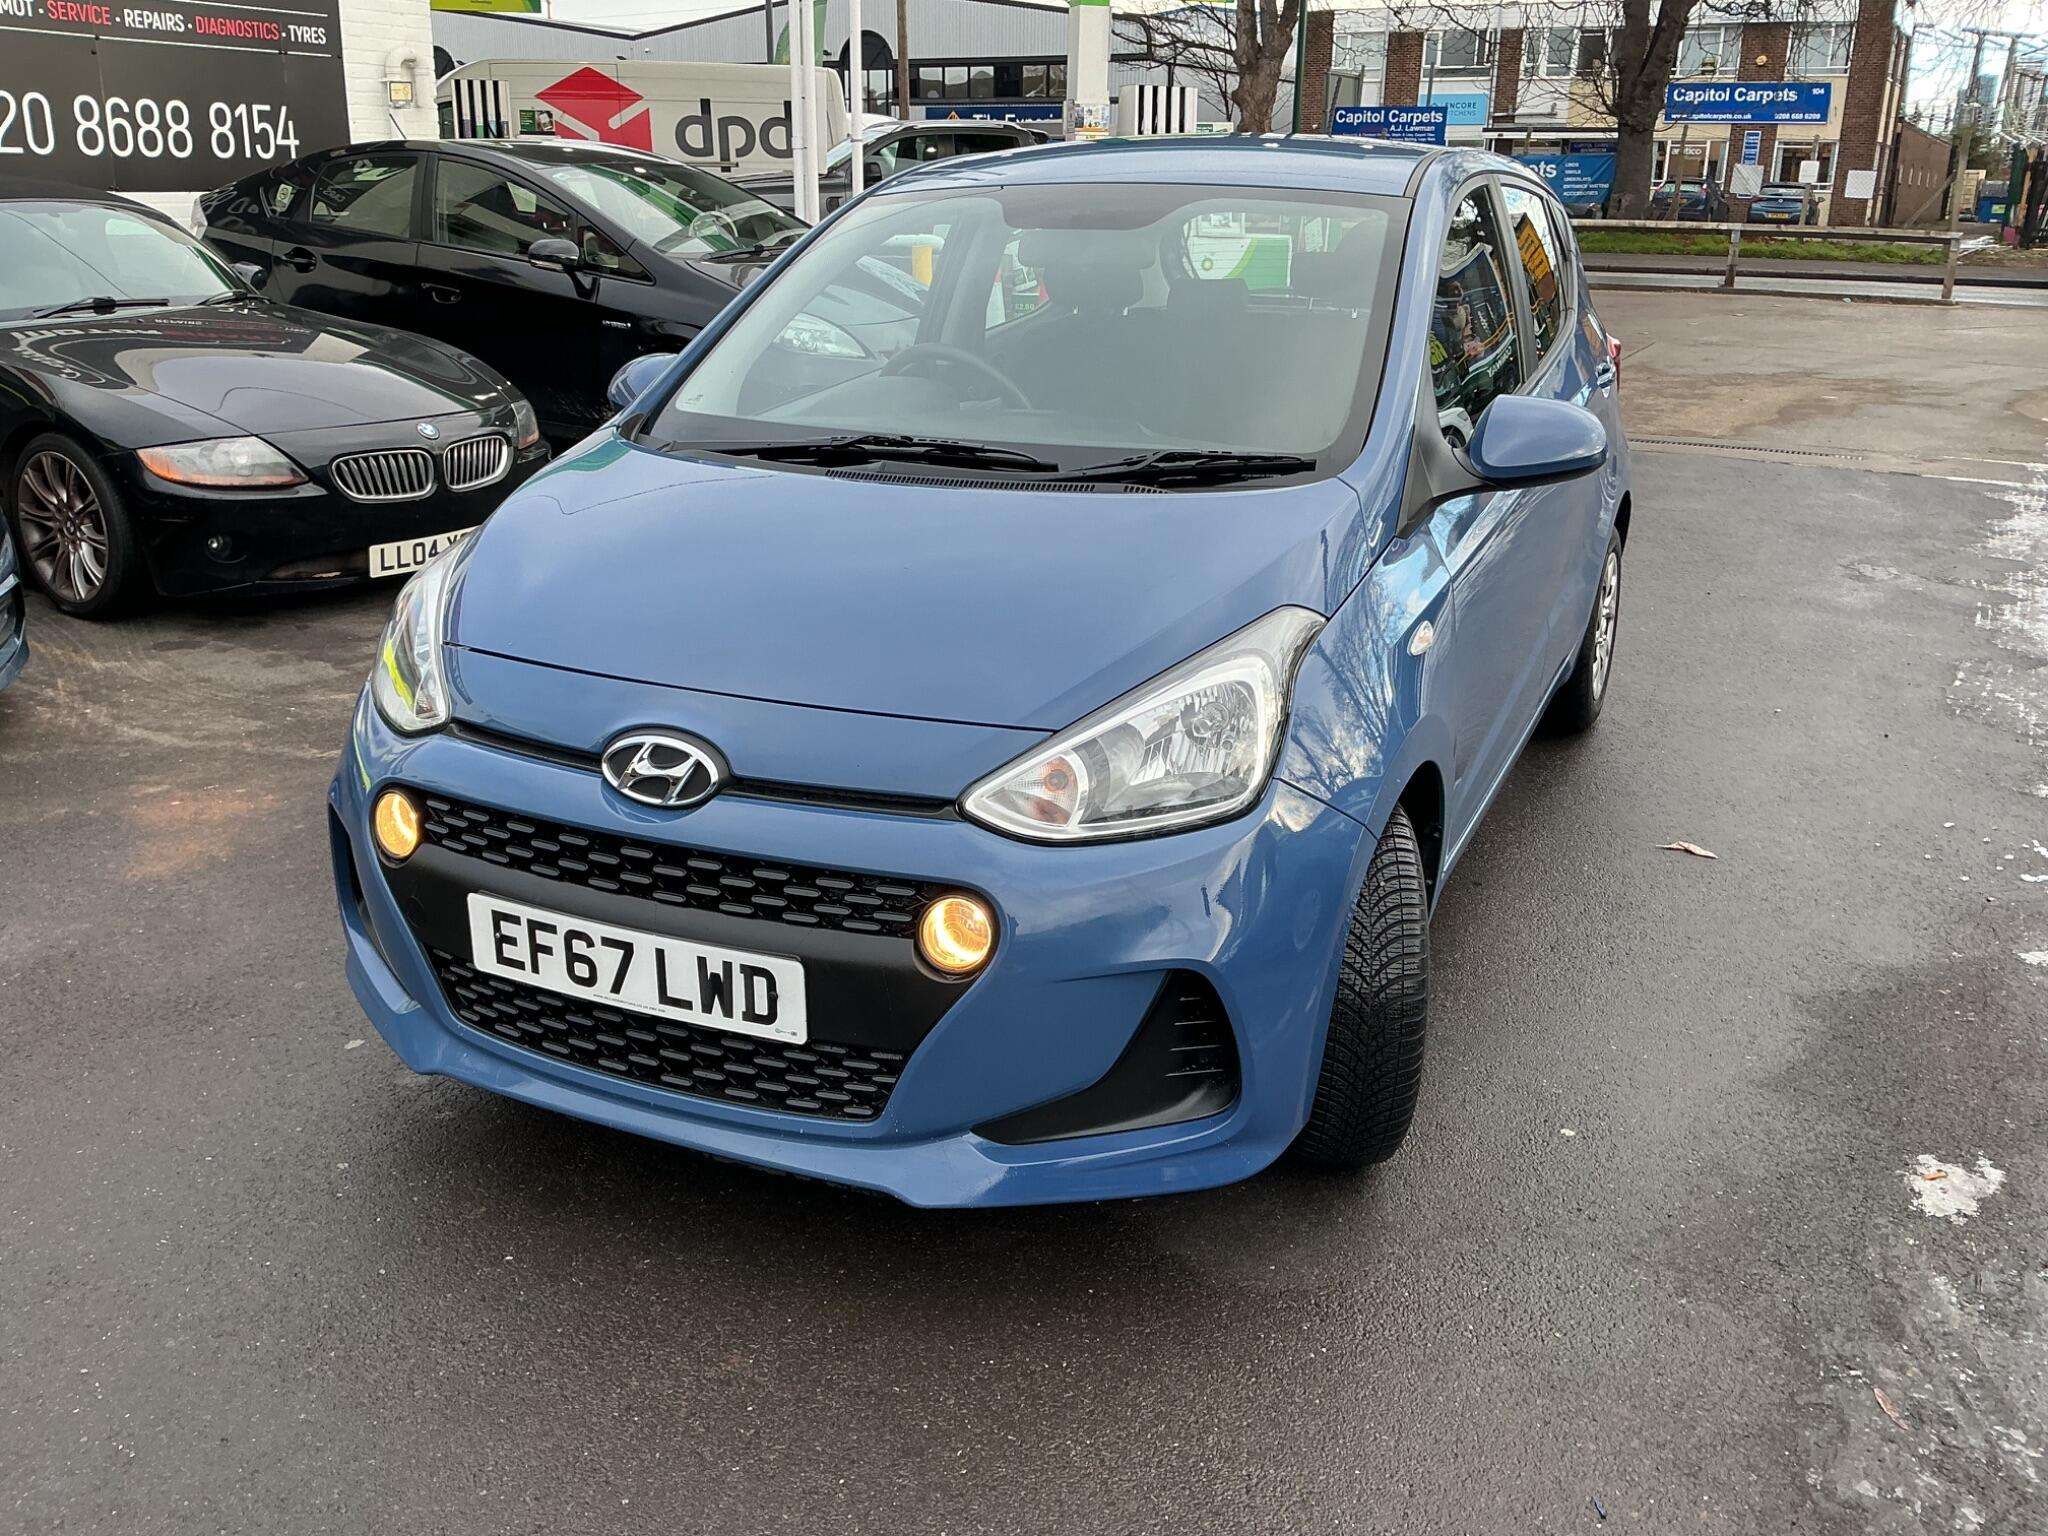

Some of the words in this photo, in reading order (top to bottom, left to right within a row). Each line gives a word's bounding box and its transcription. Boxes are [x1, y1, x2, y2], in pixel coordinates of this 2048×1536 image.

[0, 0, 33, 17] MOT
[47, 0, 112, 26] SERVICE
[123, 8, 184, 32] REPAIRS
[195, 15, 280, 41] DIAGNOSTICS
[288, 25, 326, 45] TYRES
[1673, 87, 1730, 104] Capitol
[1734, 87, 1798, 104] Carpets
[73, 94, 193, 158] 8688
[209, 101, 299, 159] 8154
[675, 98, 793, 173] dpd
[1335, 109, 1385, 125] Capitol
[1388, 109, 1443, 125] Carpets
[1389, 124, 1404, 132] A.J.
[1405, 124, 1436, 132] Lawman
[381, 539, 440, 572] LL04
[491, 909, 635, 996] EF67
[655, 947, 779, 1026] LWD
